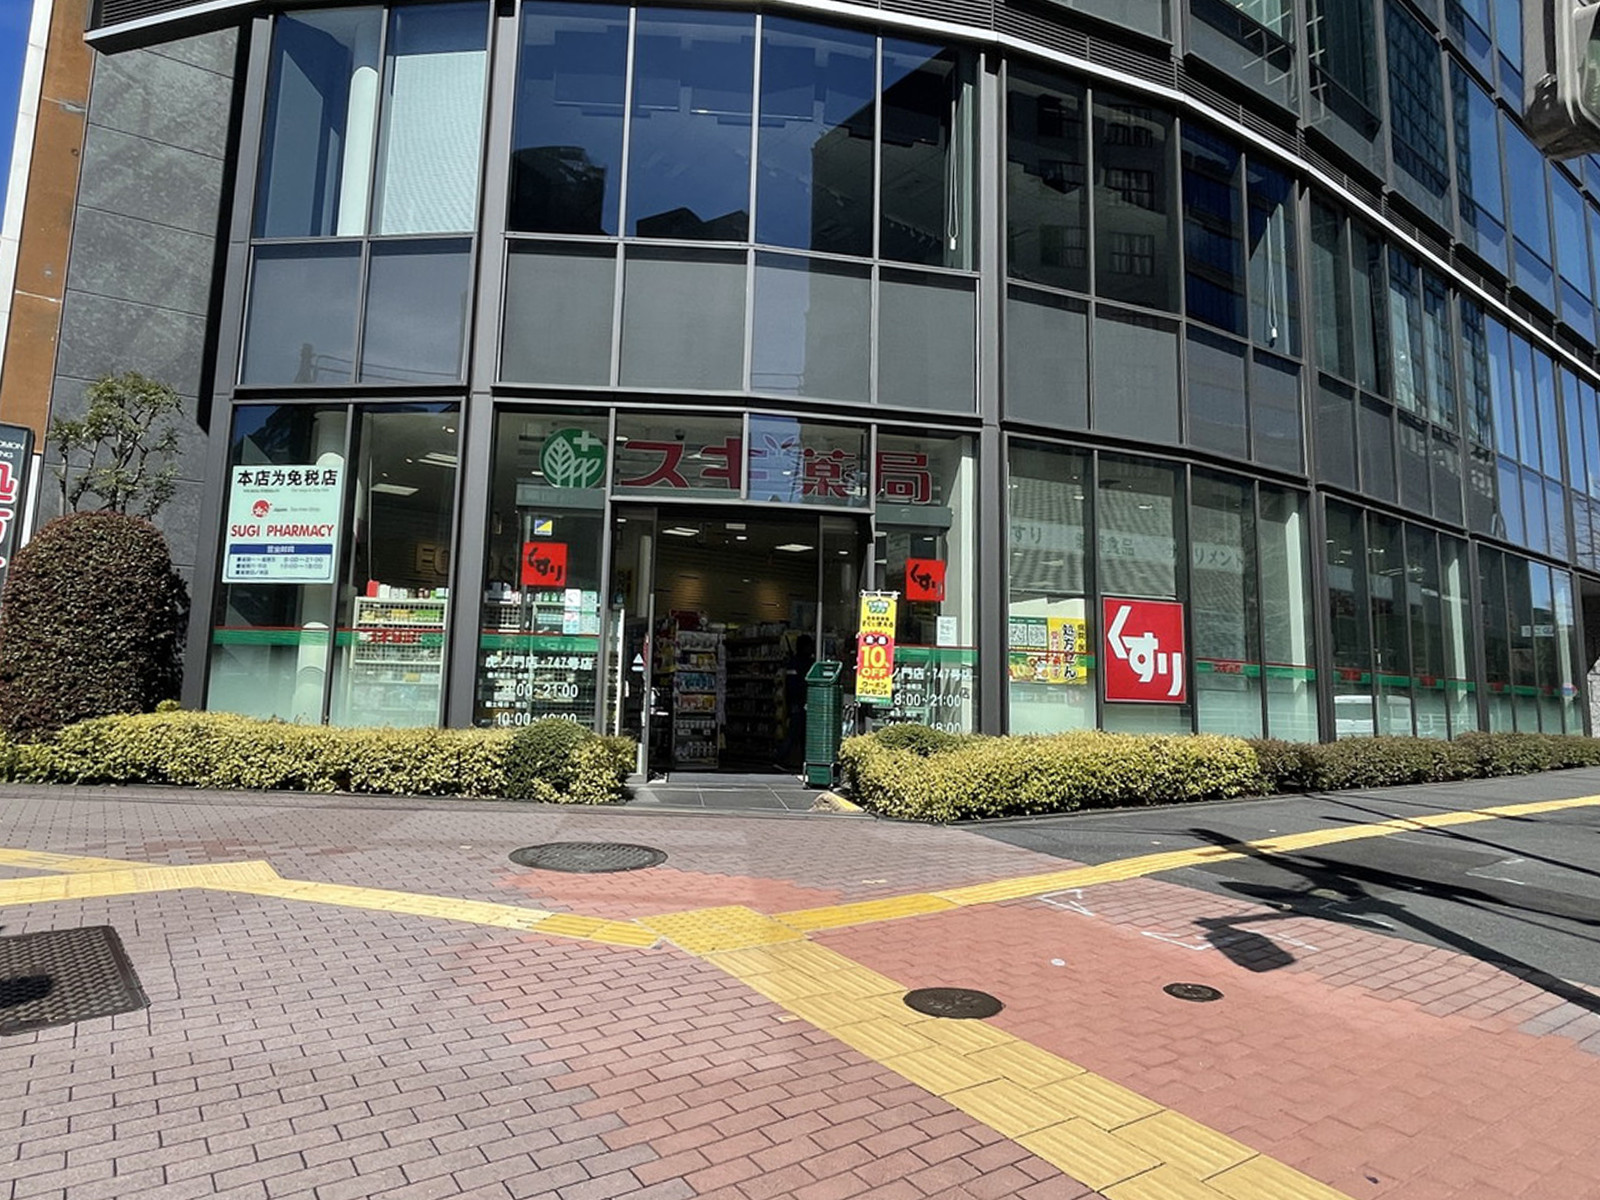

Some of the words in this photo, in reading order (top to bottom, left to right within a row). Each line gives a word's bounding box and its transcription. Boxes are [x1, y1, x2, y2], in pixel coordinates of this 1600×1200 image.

[237, 470, 338, 486] 本店为免税店
[231, 524, 261, 537] SUGI
[267, 524, 335, 537] PHARMACY
[527, 547, 561, 581] くすり
[1107, 605, 1182, 696] くすり
[861, 668, 887, 677] OFF
